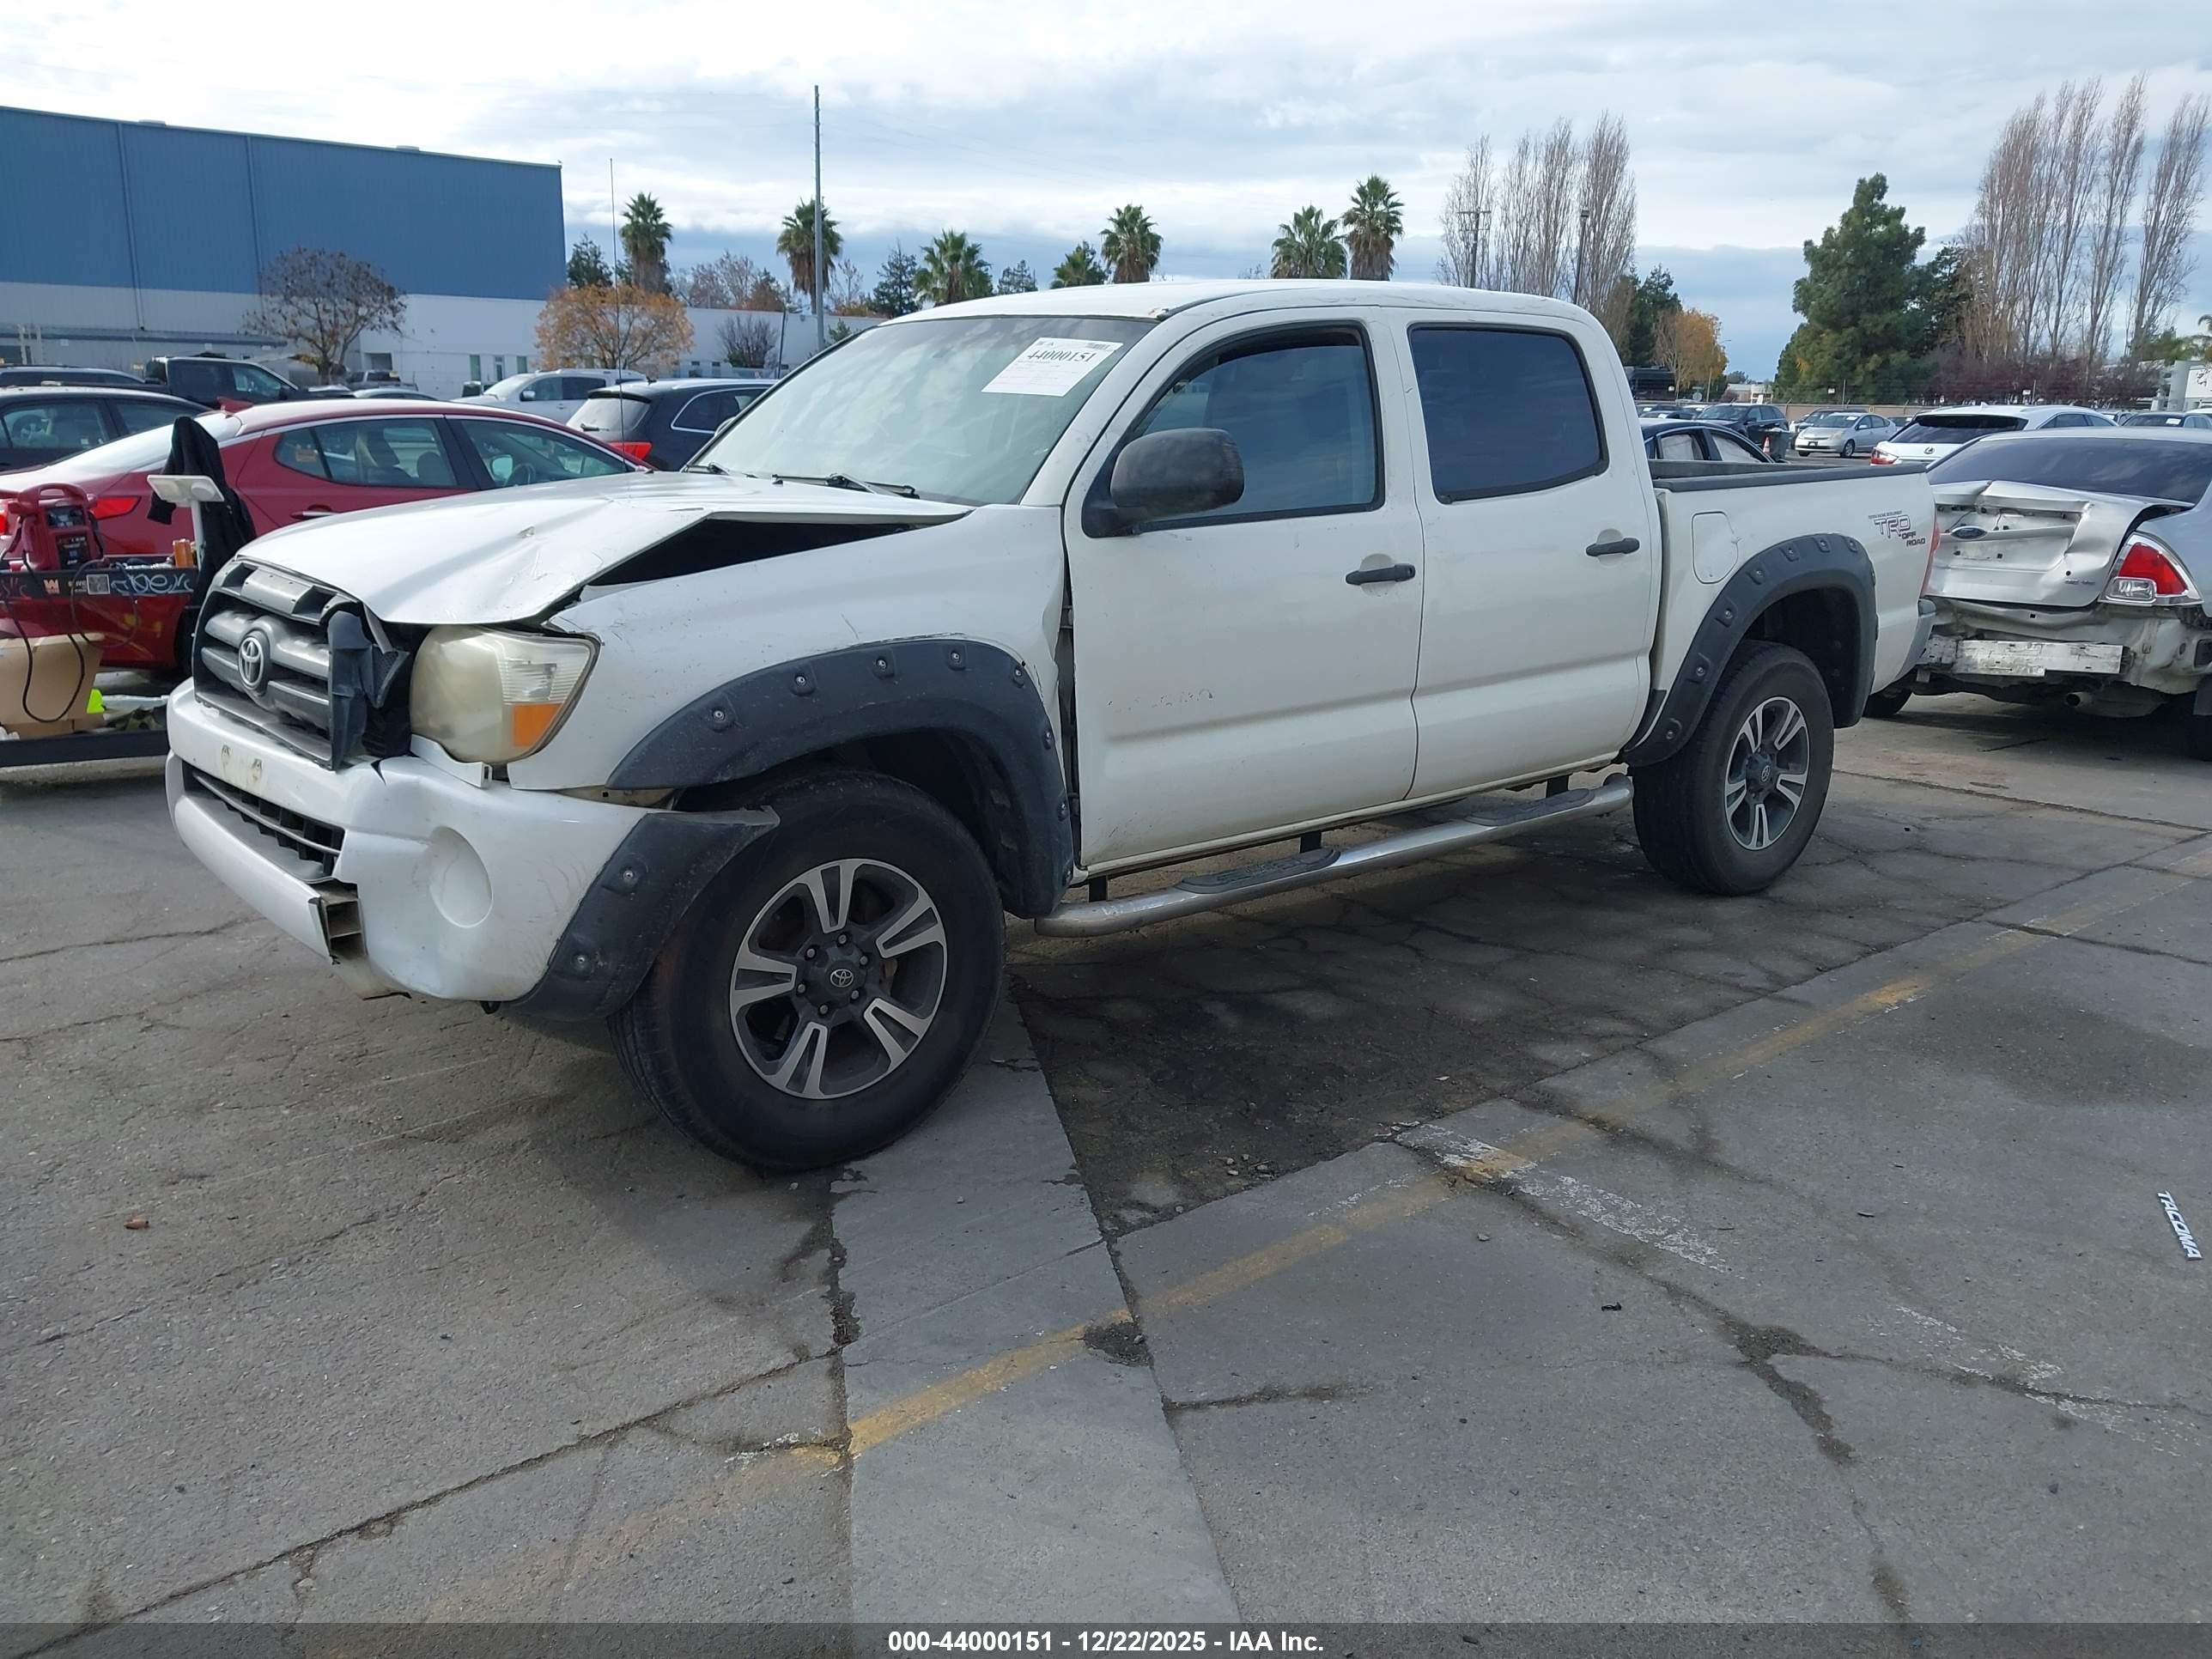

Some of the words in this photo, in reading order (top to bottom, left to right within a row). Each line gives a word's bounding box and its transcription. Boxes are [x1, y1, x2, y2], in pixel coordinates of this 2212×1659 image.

[1028, 349, 1097, 362] 44000151
[1874, 515, 1911, 539] TRD
[1901, 531, 1917, 539] OFF
[1906, 538, 1926, 547] ROAD
[2157, 1190, 2203, 1260] TACOMA
